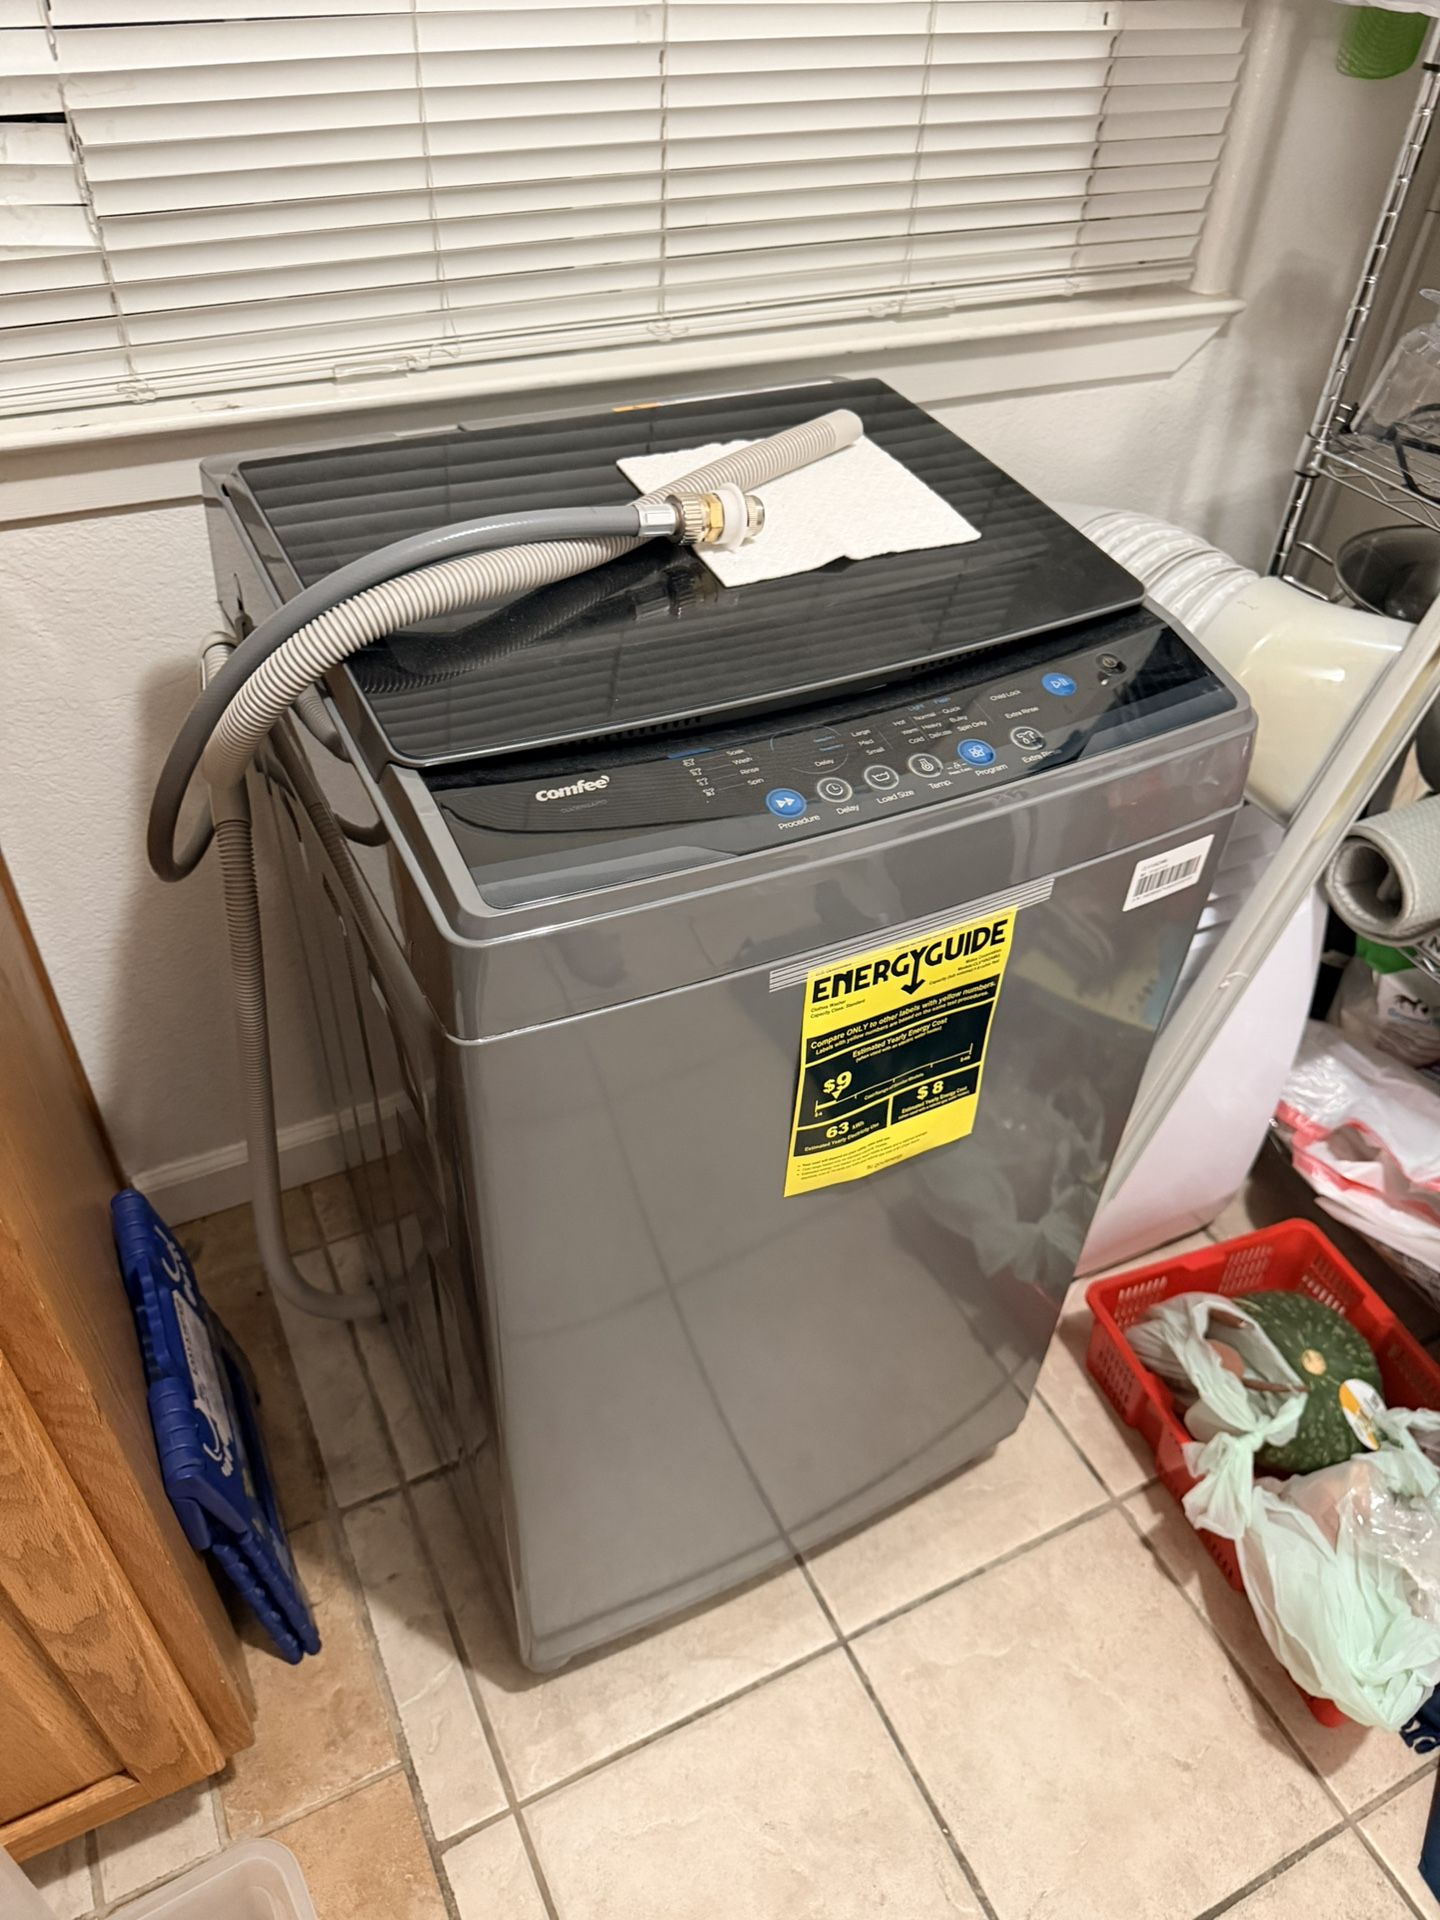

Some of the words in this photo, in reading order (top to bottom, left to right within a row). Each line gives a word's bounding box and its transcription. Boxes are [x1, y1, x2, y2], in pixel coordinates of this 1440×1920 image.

[975, 763, 1009, 777] Program
[876, 791, 898, 804] Load
[897, 788, 915, 799] Size
[835, 804, 860, 816] Delay
[777, 814, 821, 830] Procedure
[812, 918, 1009, 1004] ENERGYGUIDE
[810, 1030, 845, 1050] Compare
[846, 1021, 869, 1036] ONLY
[869, 1019, 878, 1028] to
[878, 1013, 899, 1025] other
[899, 1005, 921, 1017] labels
[922, 998, 938, 1009] with
[938, 990, 962, 1005] yellow
[963, 981, 996, 996] numbers.
[852, 1039, 886, 1058] Estimated
[887, 1032, 908, 1045] Yearly
[908, 1024, 931, 1037] Energy
[931, 1017, 948, 1028] Cost
[822, 1070, 852, 1095] $9
[825, 1121, 850, 1139] 63
